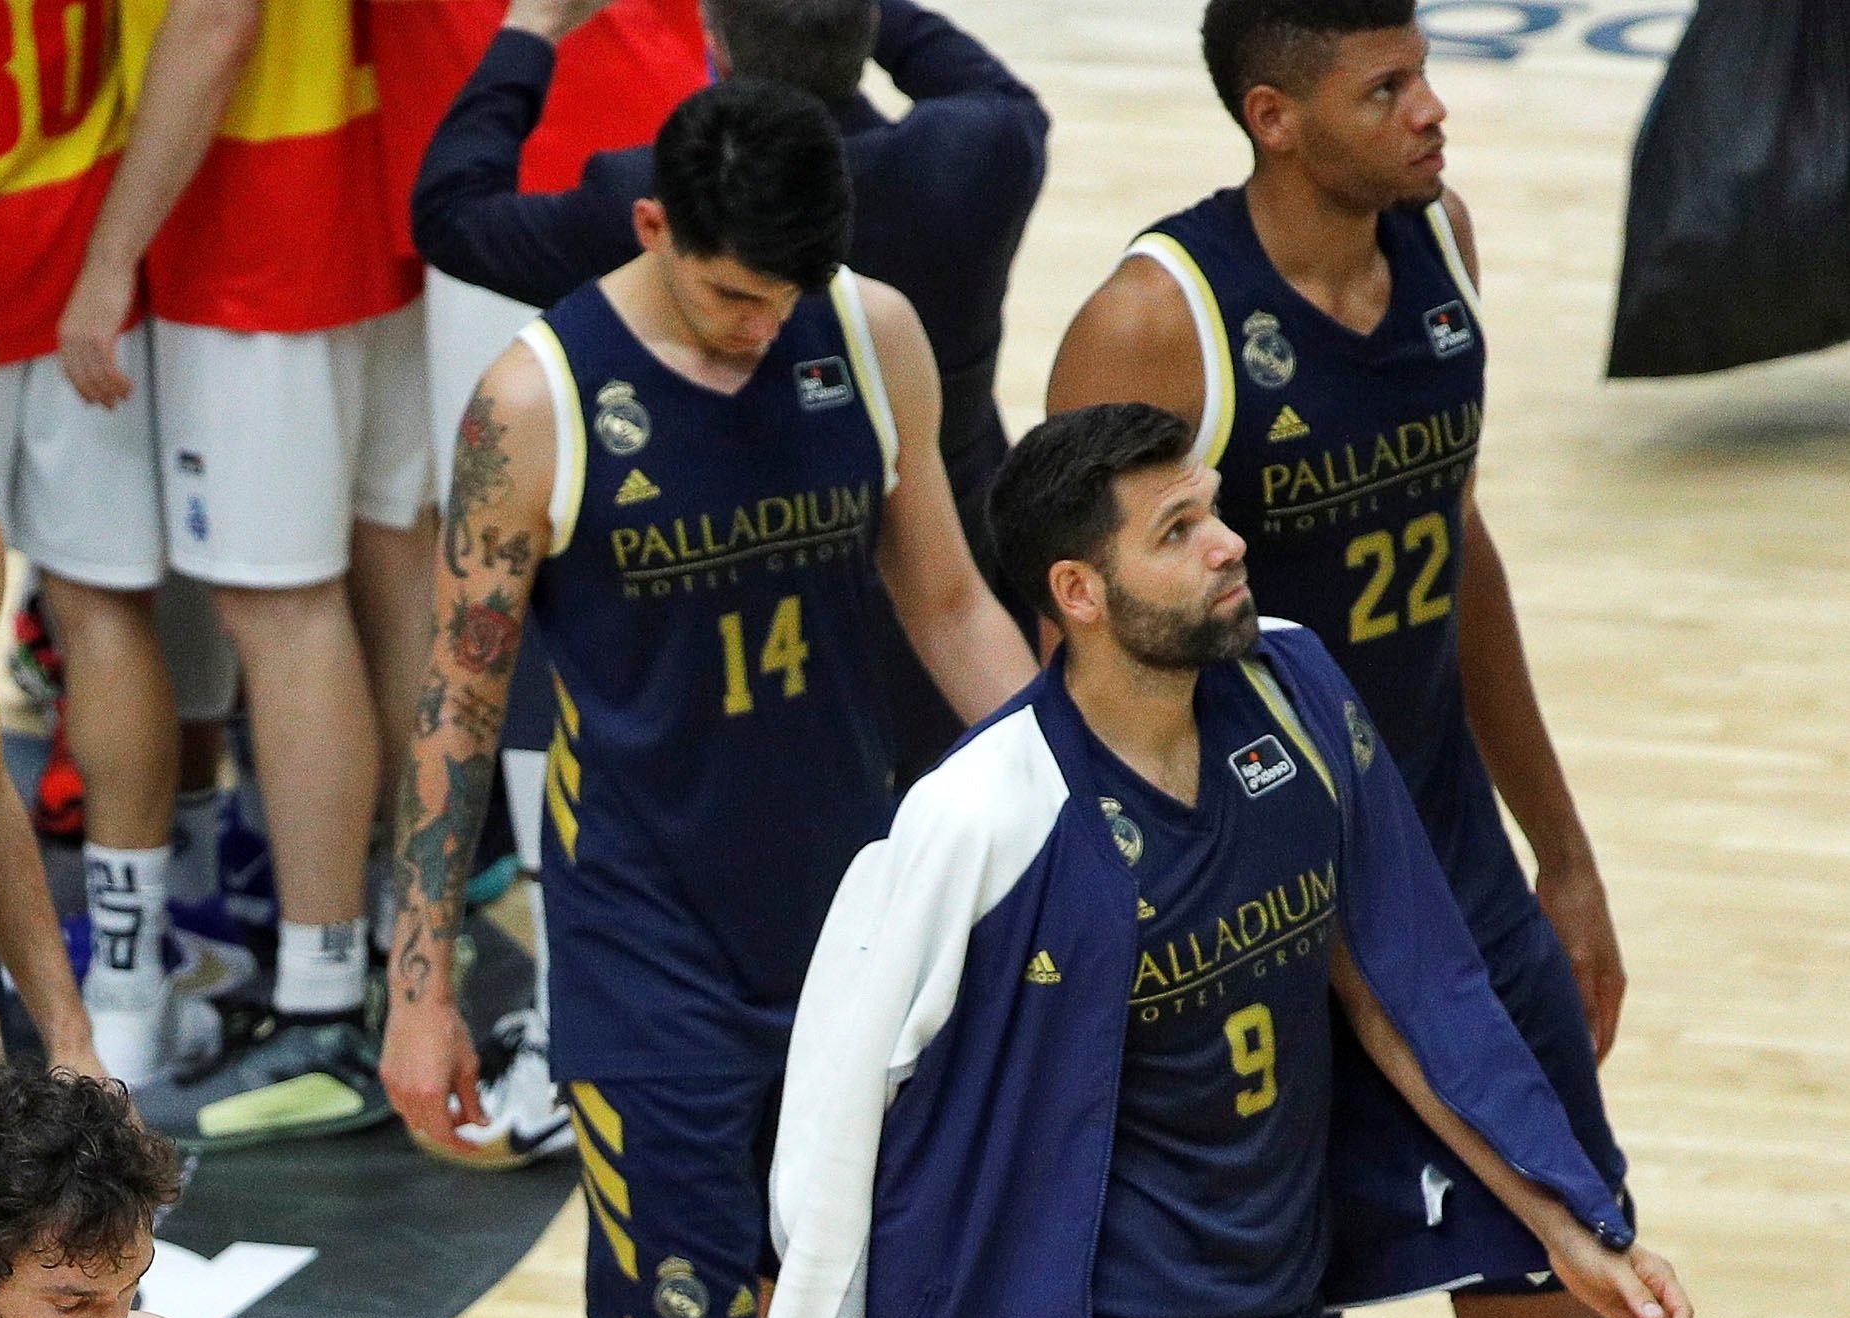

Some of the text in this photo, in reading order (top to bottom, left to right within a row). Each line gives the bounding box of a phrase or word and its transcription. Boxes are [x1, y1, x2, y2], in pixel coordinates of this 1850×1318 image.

[1345, 510, 1453, 644] 22
[717, 594, 811, 717] 14
[1133, 859, 1337, 994] ALLADIUM
[1224, 1002, 1279, 1117] 9
